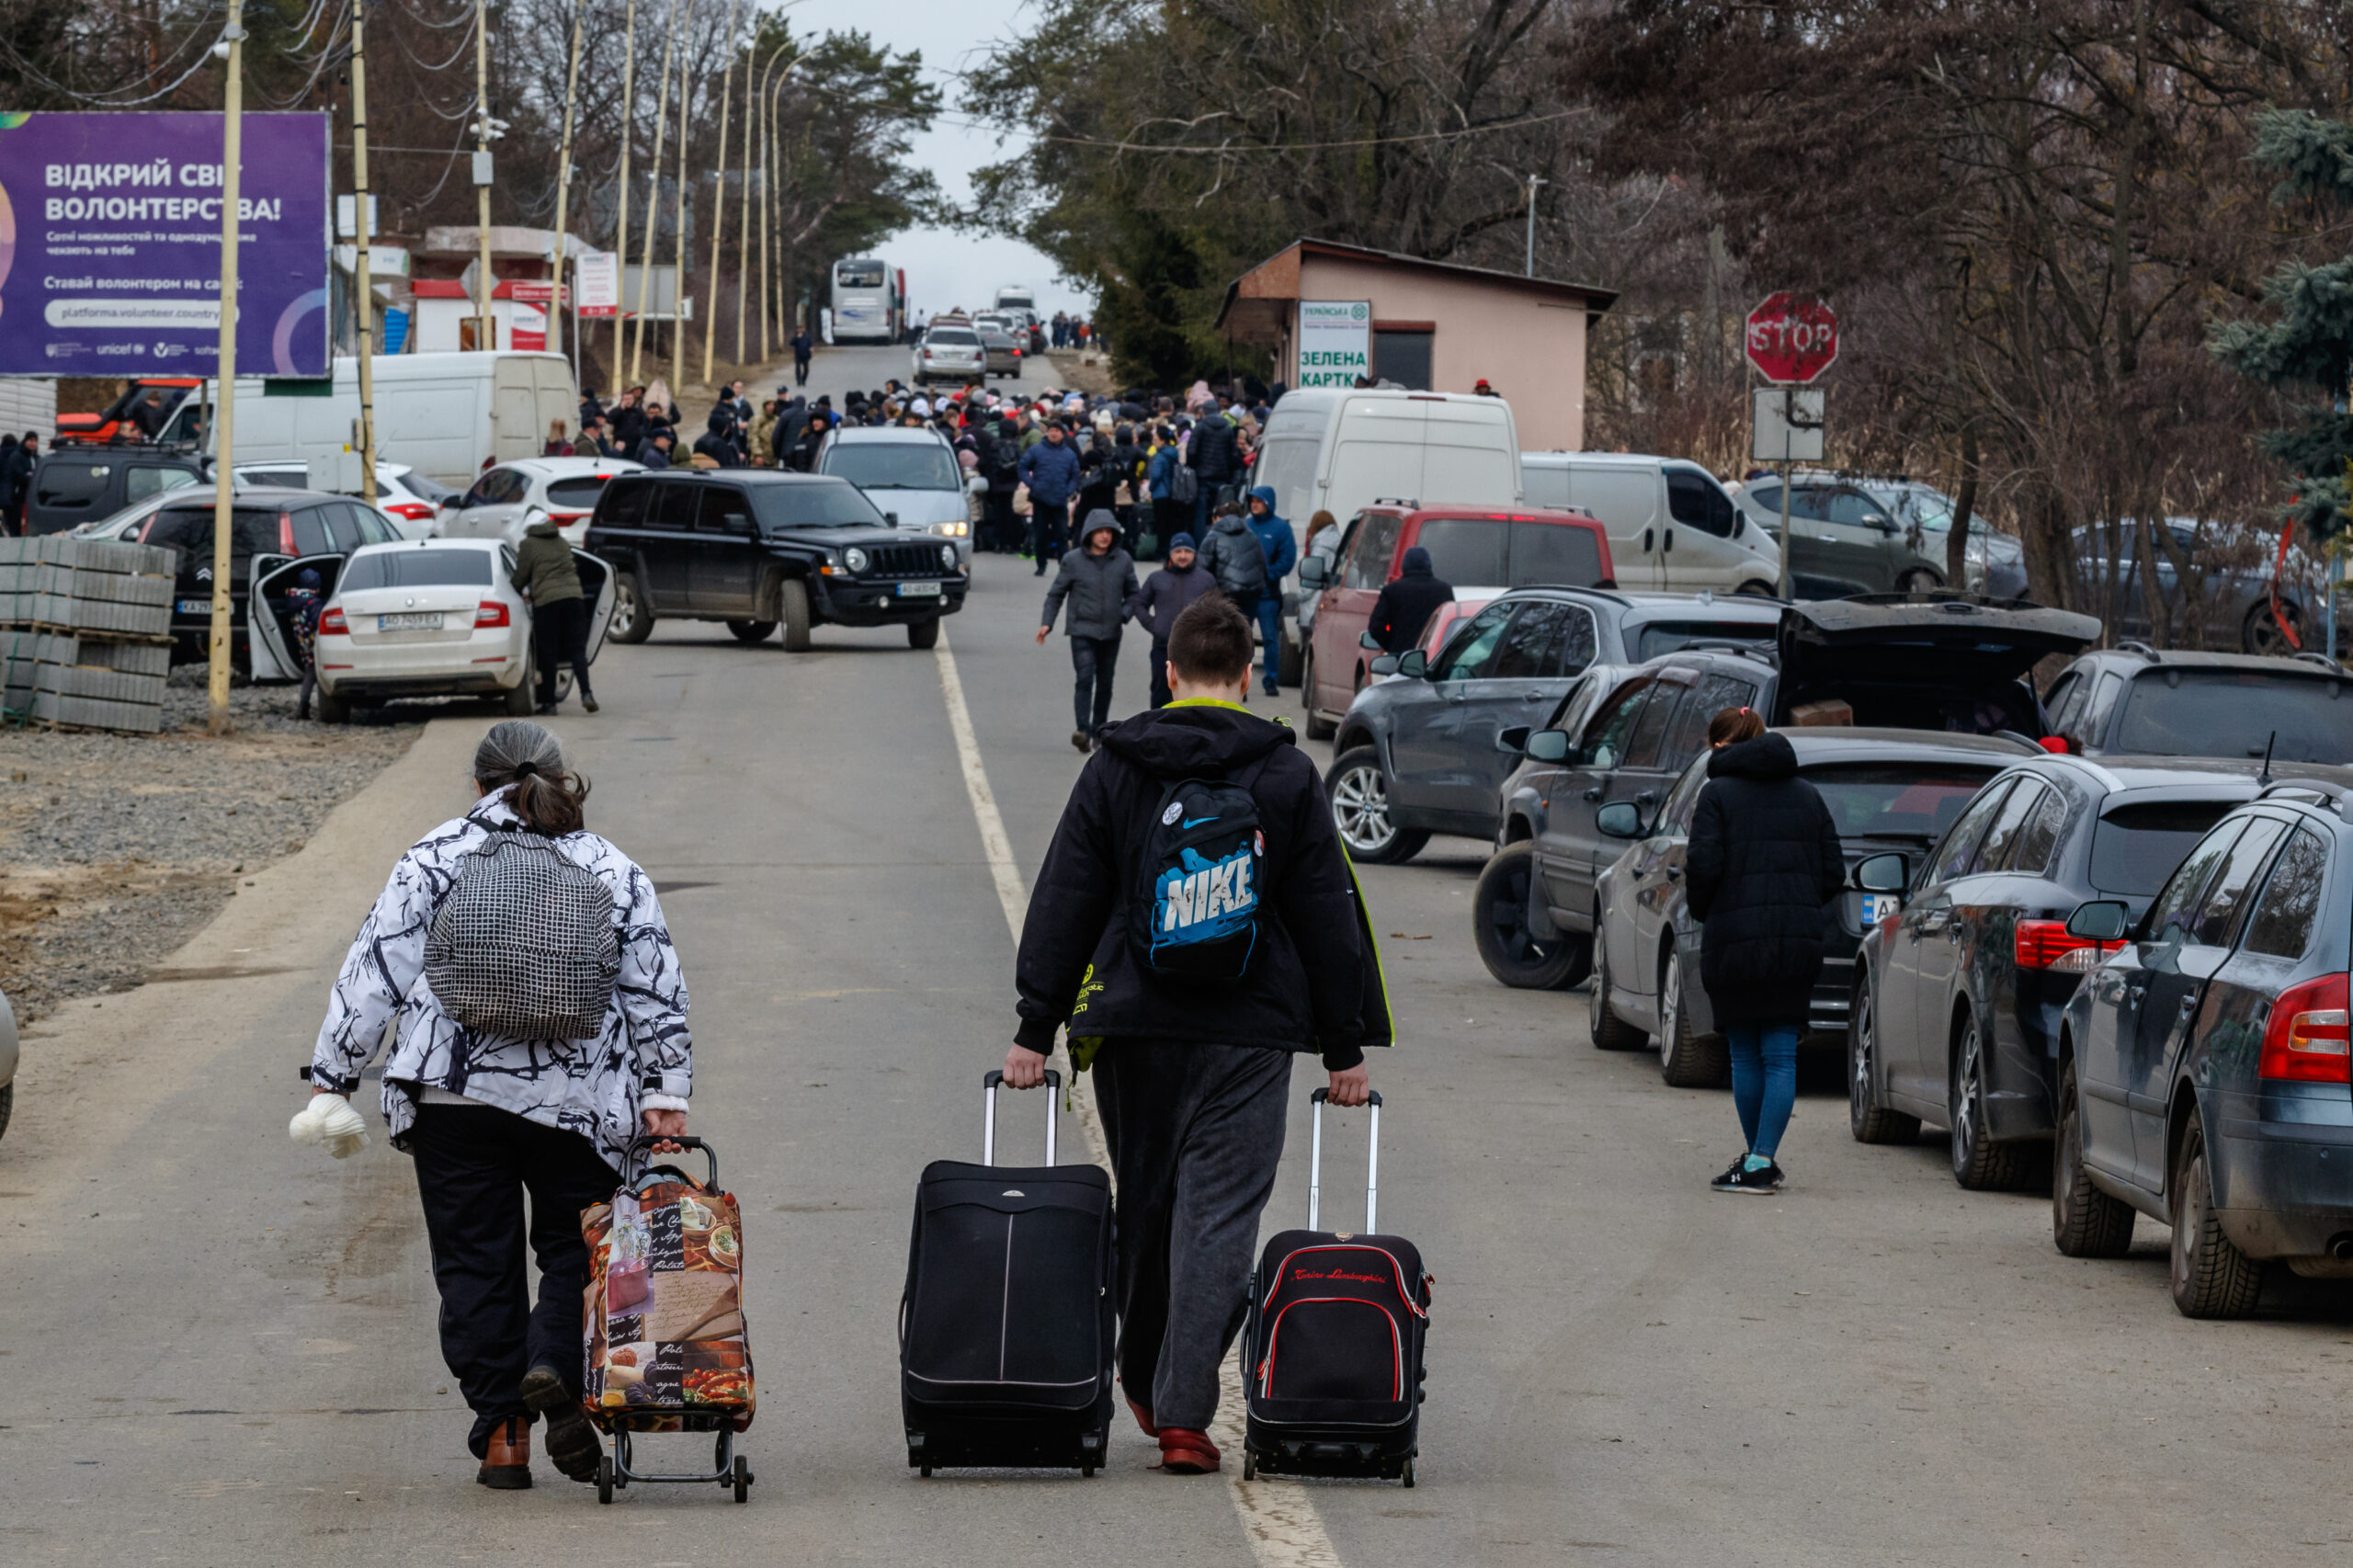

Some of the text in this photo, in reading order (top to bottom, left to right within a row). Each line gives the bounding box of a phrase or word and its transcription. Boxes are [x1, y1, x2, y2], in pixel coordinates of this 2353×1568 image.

[46, 158, 244, 190] ВІДКРИЙ СВІ
[154, 233, 166, 242] та
[168, 233, 223, 244] однодумц
[95, 246, 108, 256] на
[111, 245, 135, 256] тебе
[44, 277, 93, 290] Ставай
[97, 278, 181, 291] волонтером
[184, 279, 200, 290] на
[62, 307, 220, 321] platforma.volunteer.country
[1753, 322, 1833, 352] STOP
[97, 343, 131, 356] unicef
[1301, 352, 1366, 366] ЗЕЛЕНА
[1164, 853, 1253, 932] NIKE
